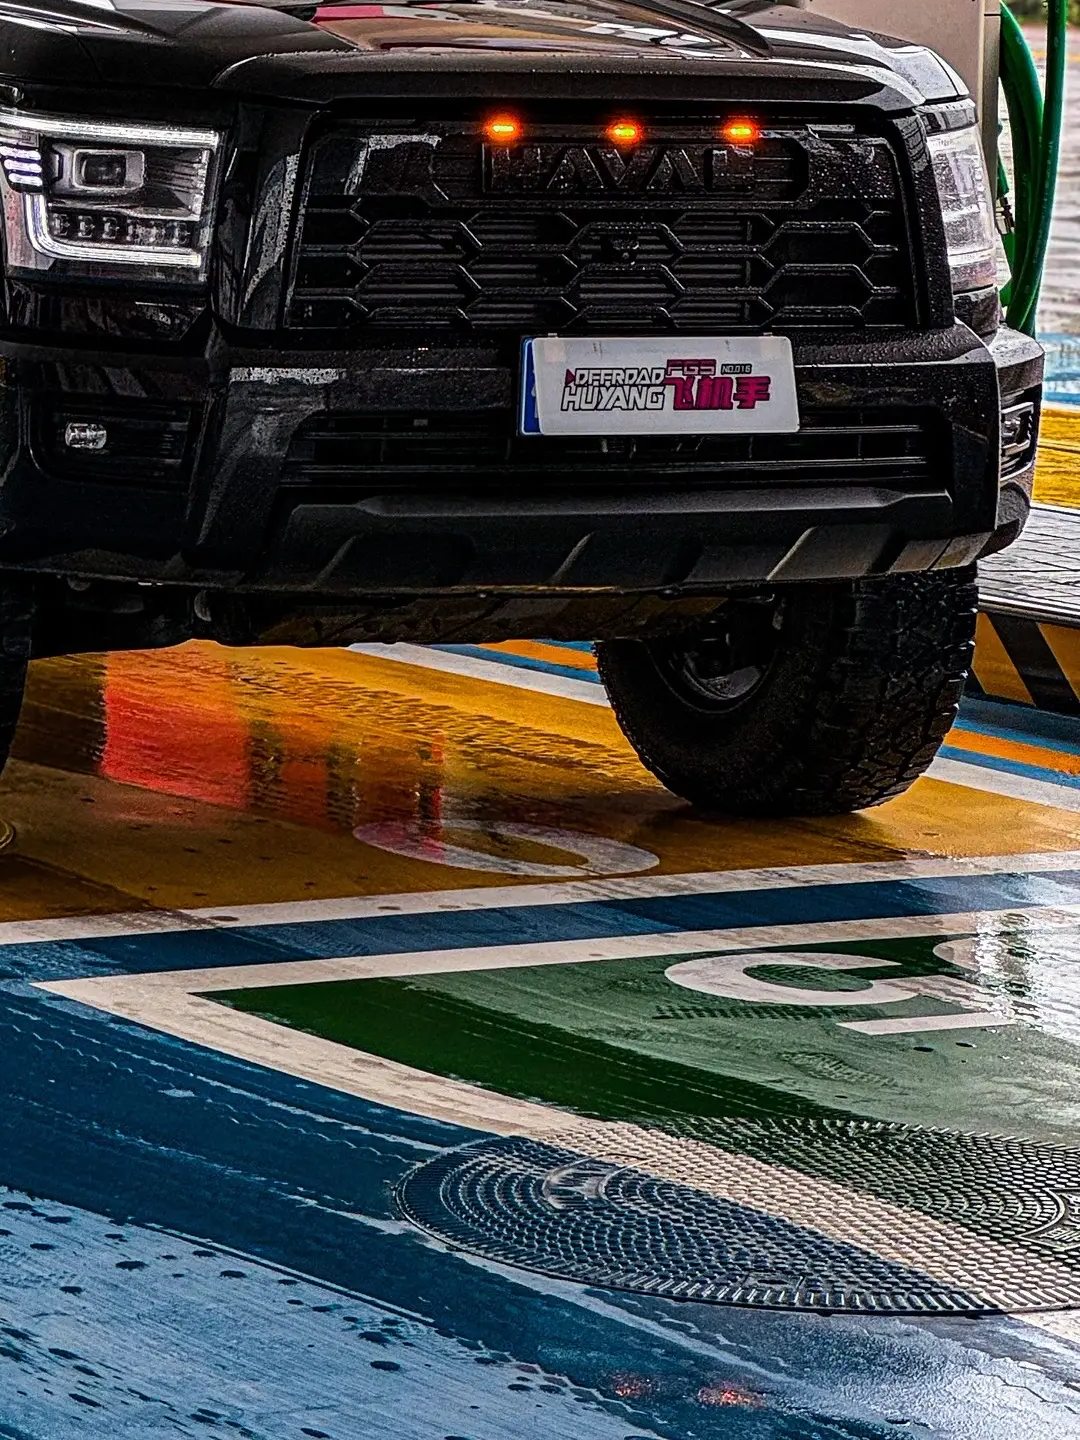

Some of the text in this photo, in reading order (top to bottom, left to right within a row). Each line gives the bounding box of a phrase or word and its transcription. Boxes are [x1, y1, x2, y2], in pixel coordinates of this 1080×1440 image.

[560, 383, 666, 411] HUYANG
[663, 375, 772, 411] 飞机手
